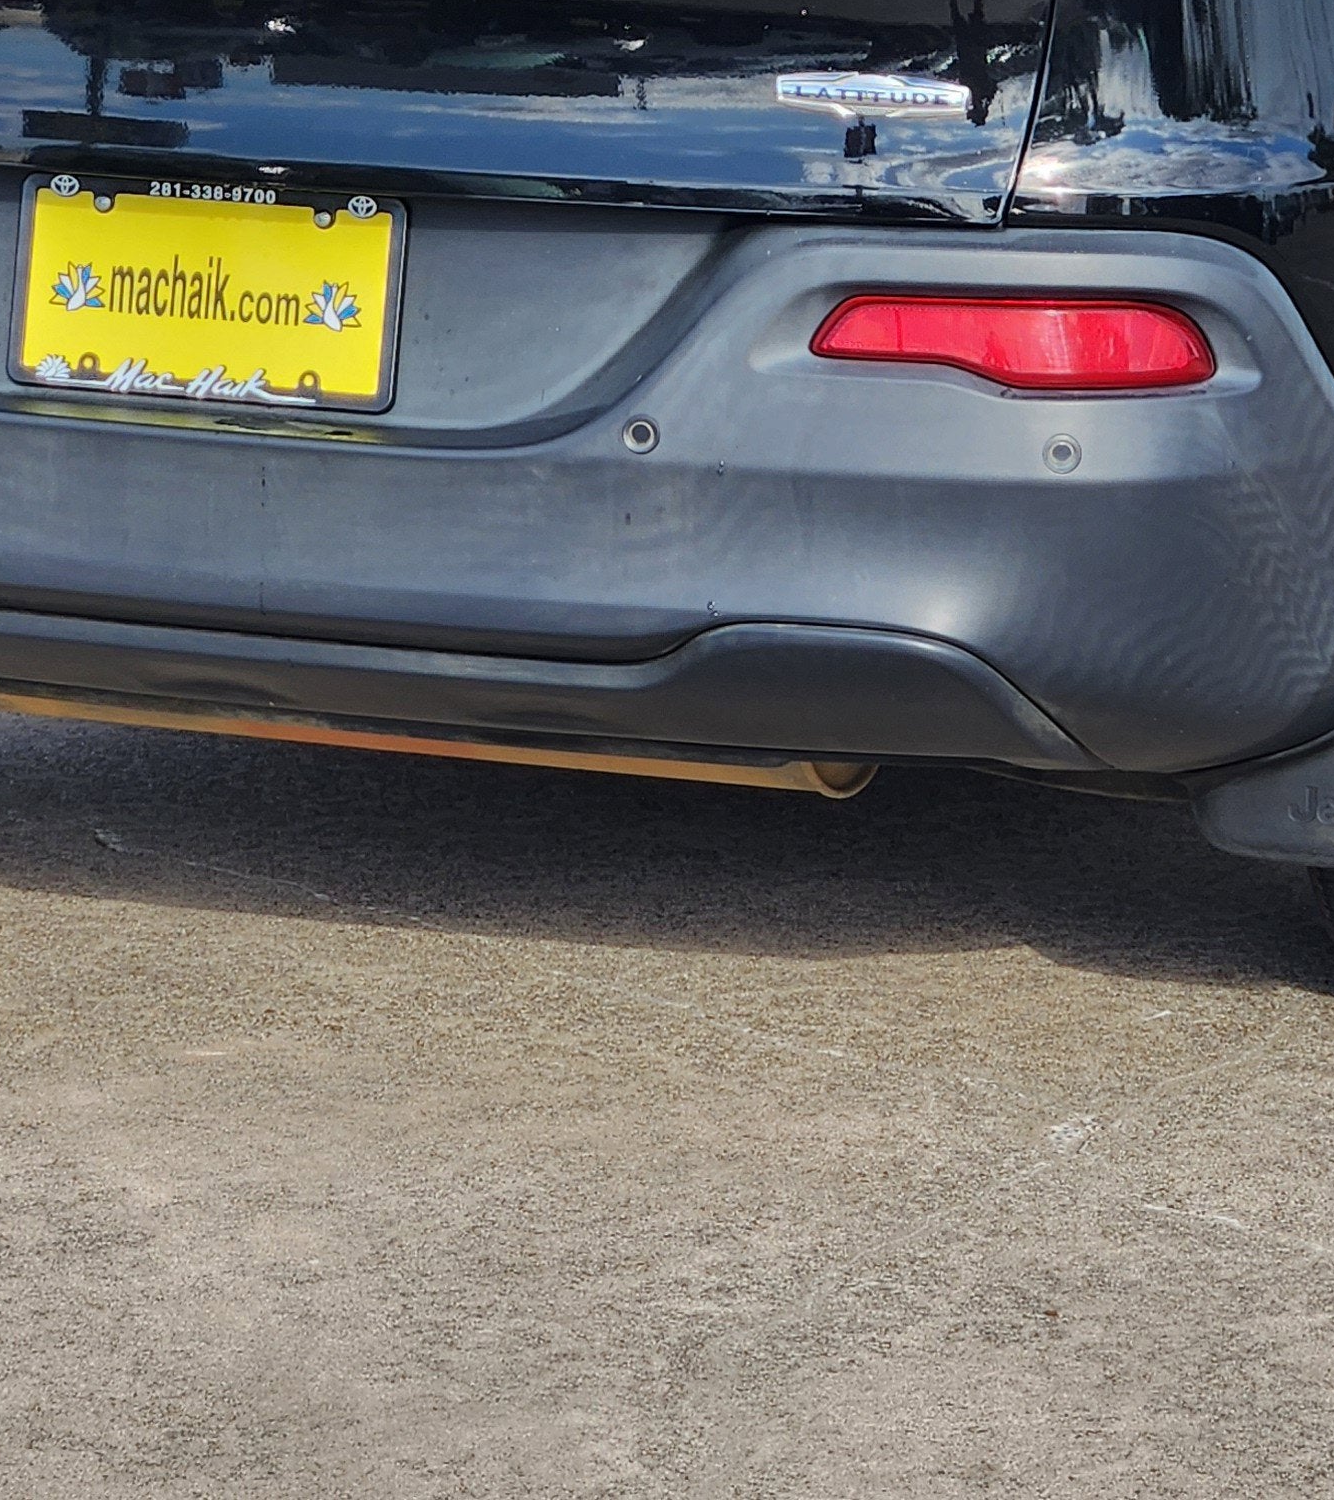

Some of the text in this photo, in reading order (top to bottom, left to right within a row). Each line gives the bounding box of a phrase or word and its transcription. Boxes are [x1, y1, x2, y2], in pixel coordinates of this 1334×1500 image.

[795, 85, 949, 106] LATITUDE
[150, 181, 277, 205] 281-338-9700
[108, 254, 301, 327] machaik.com
[97, 357, 317, 403] Mac Haik
